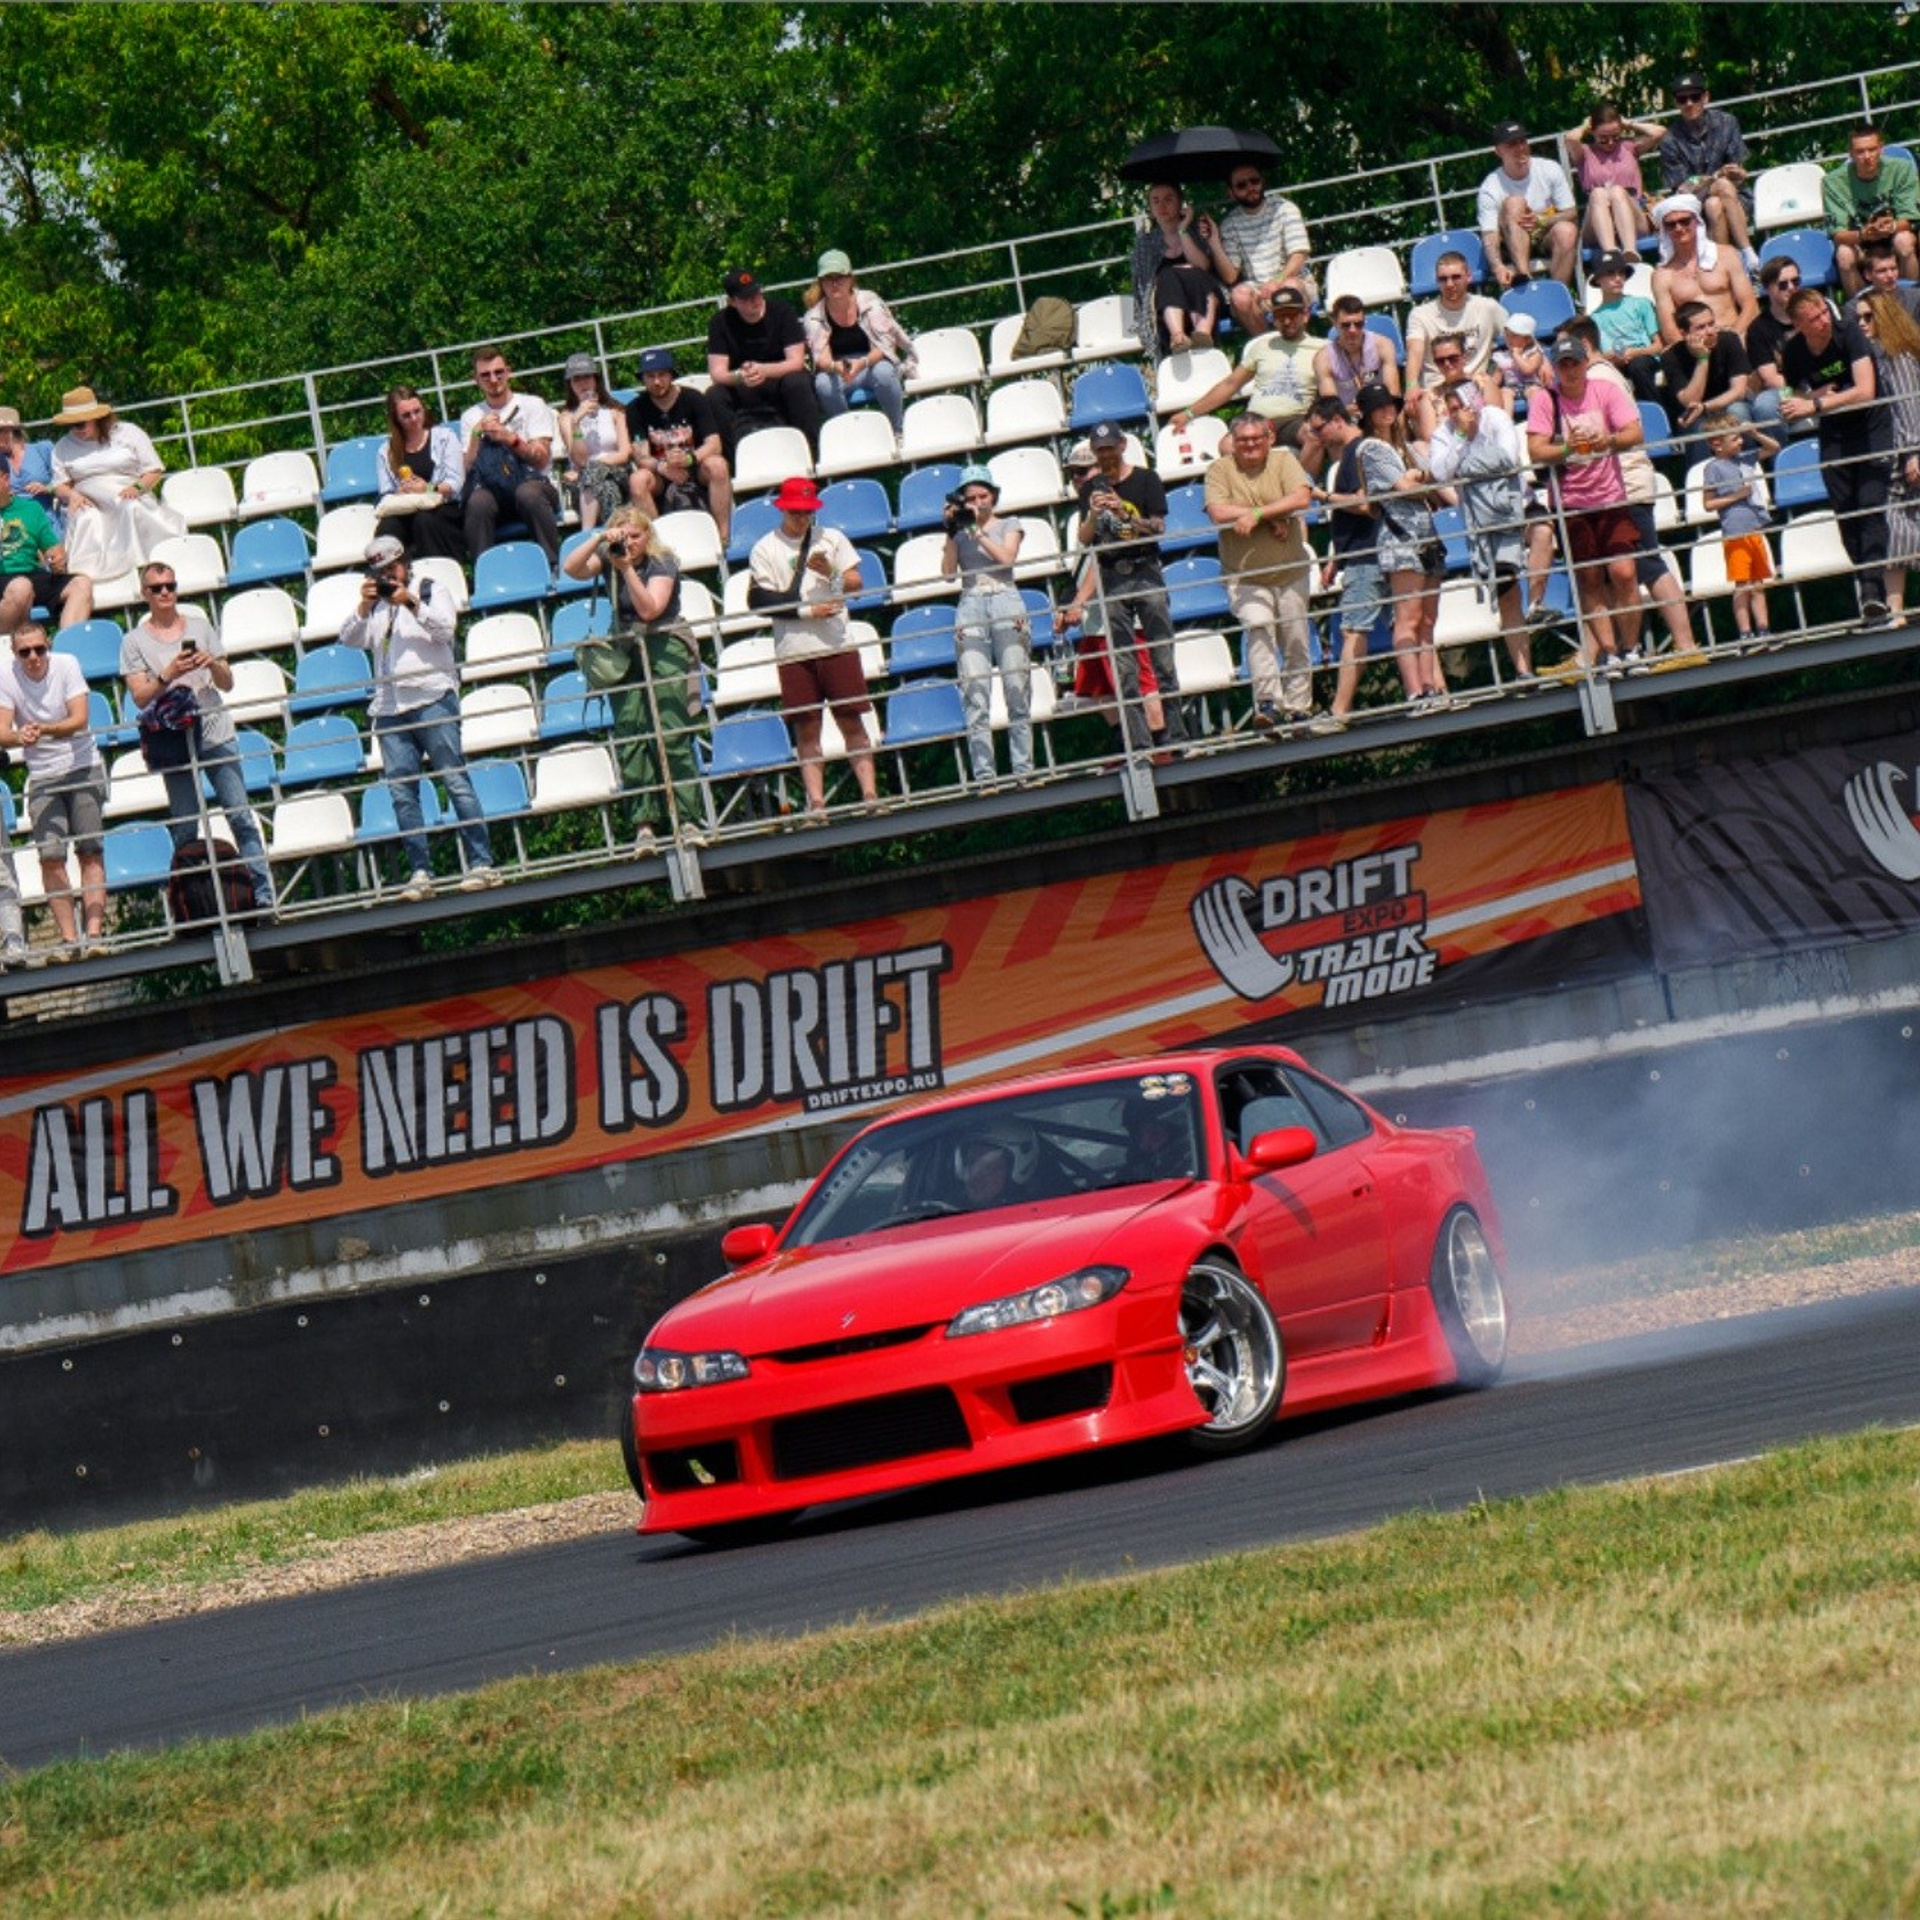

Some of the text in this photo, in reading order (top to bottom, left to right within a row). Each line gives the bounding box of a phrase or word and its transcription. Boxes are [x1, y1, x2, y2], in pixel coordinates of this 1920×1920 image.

[1261, 844, 1420, 929] DRIFT
[1343, 902, 1407, 932] EXPO
[22, 944, 943, 1234] ALL WE NEED IS DRIFT
[807, 1072, 938, 1110] DRIFTEXPO.RU
